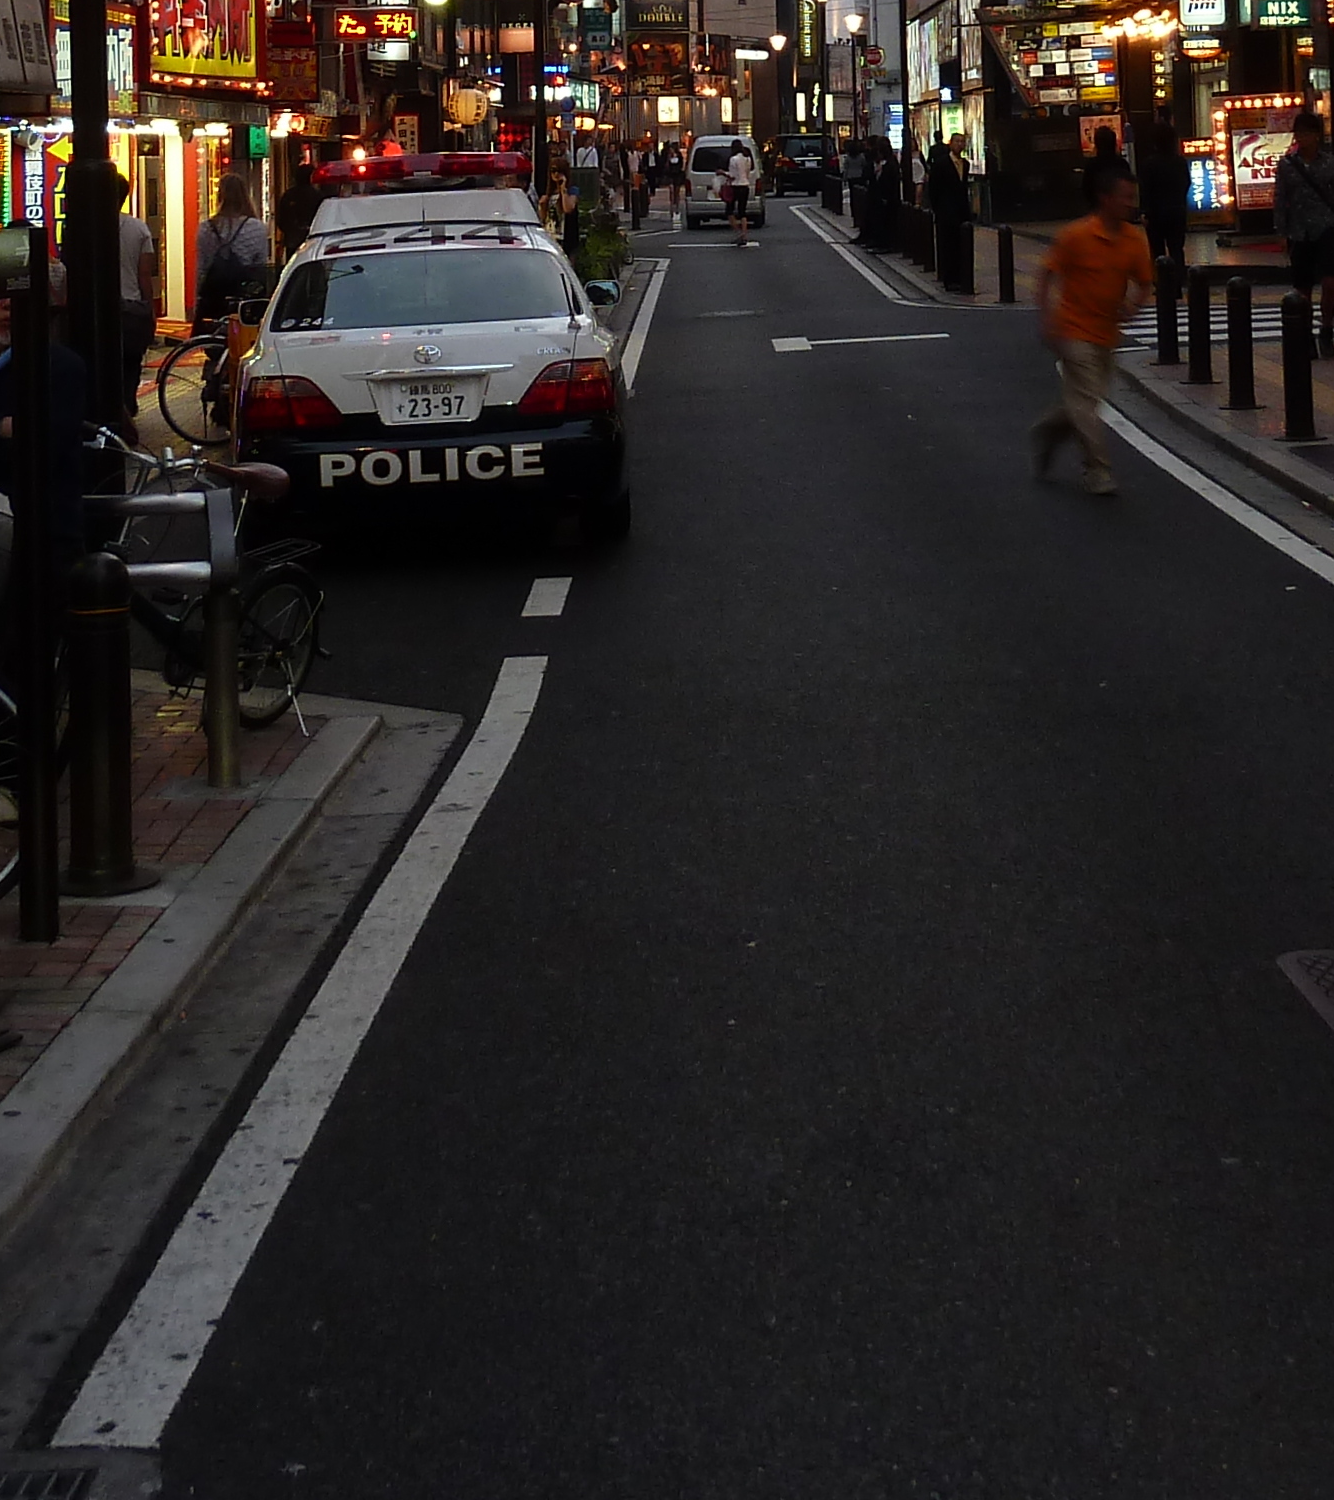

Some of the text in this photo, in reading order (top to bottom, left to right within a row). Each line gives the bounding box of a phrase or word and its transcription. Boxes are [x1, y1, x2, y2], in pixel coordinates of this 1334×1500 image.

[1267, 1, 1299, 15] NIX
[374, 13, 413, 35] 予約
[408, 395, 466, 419] 23-97
[319, 442, 547, 489] POLICE
